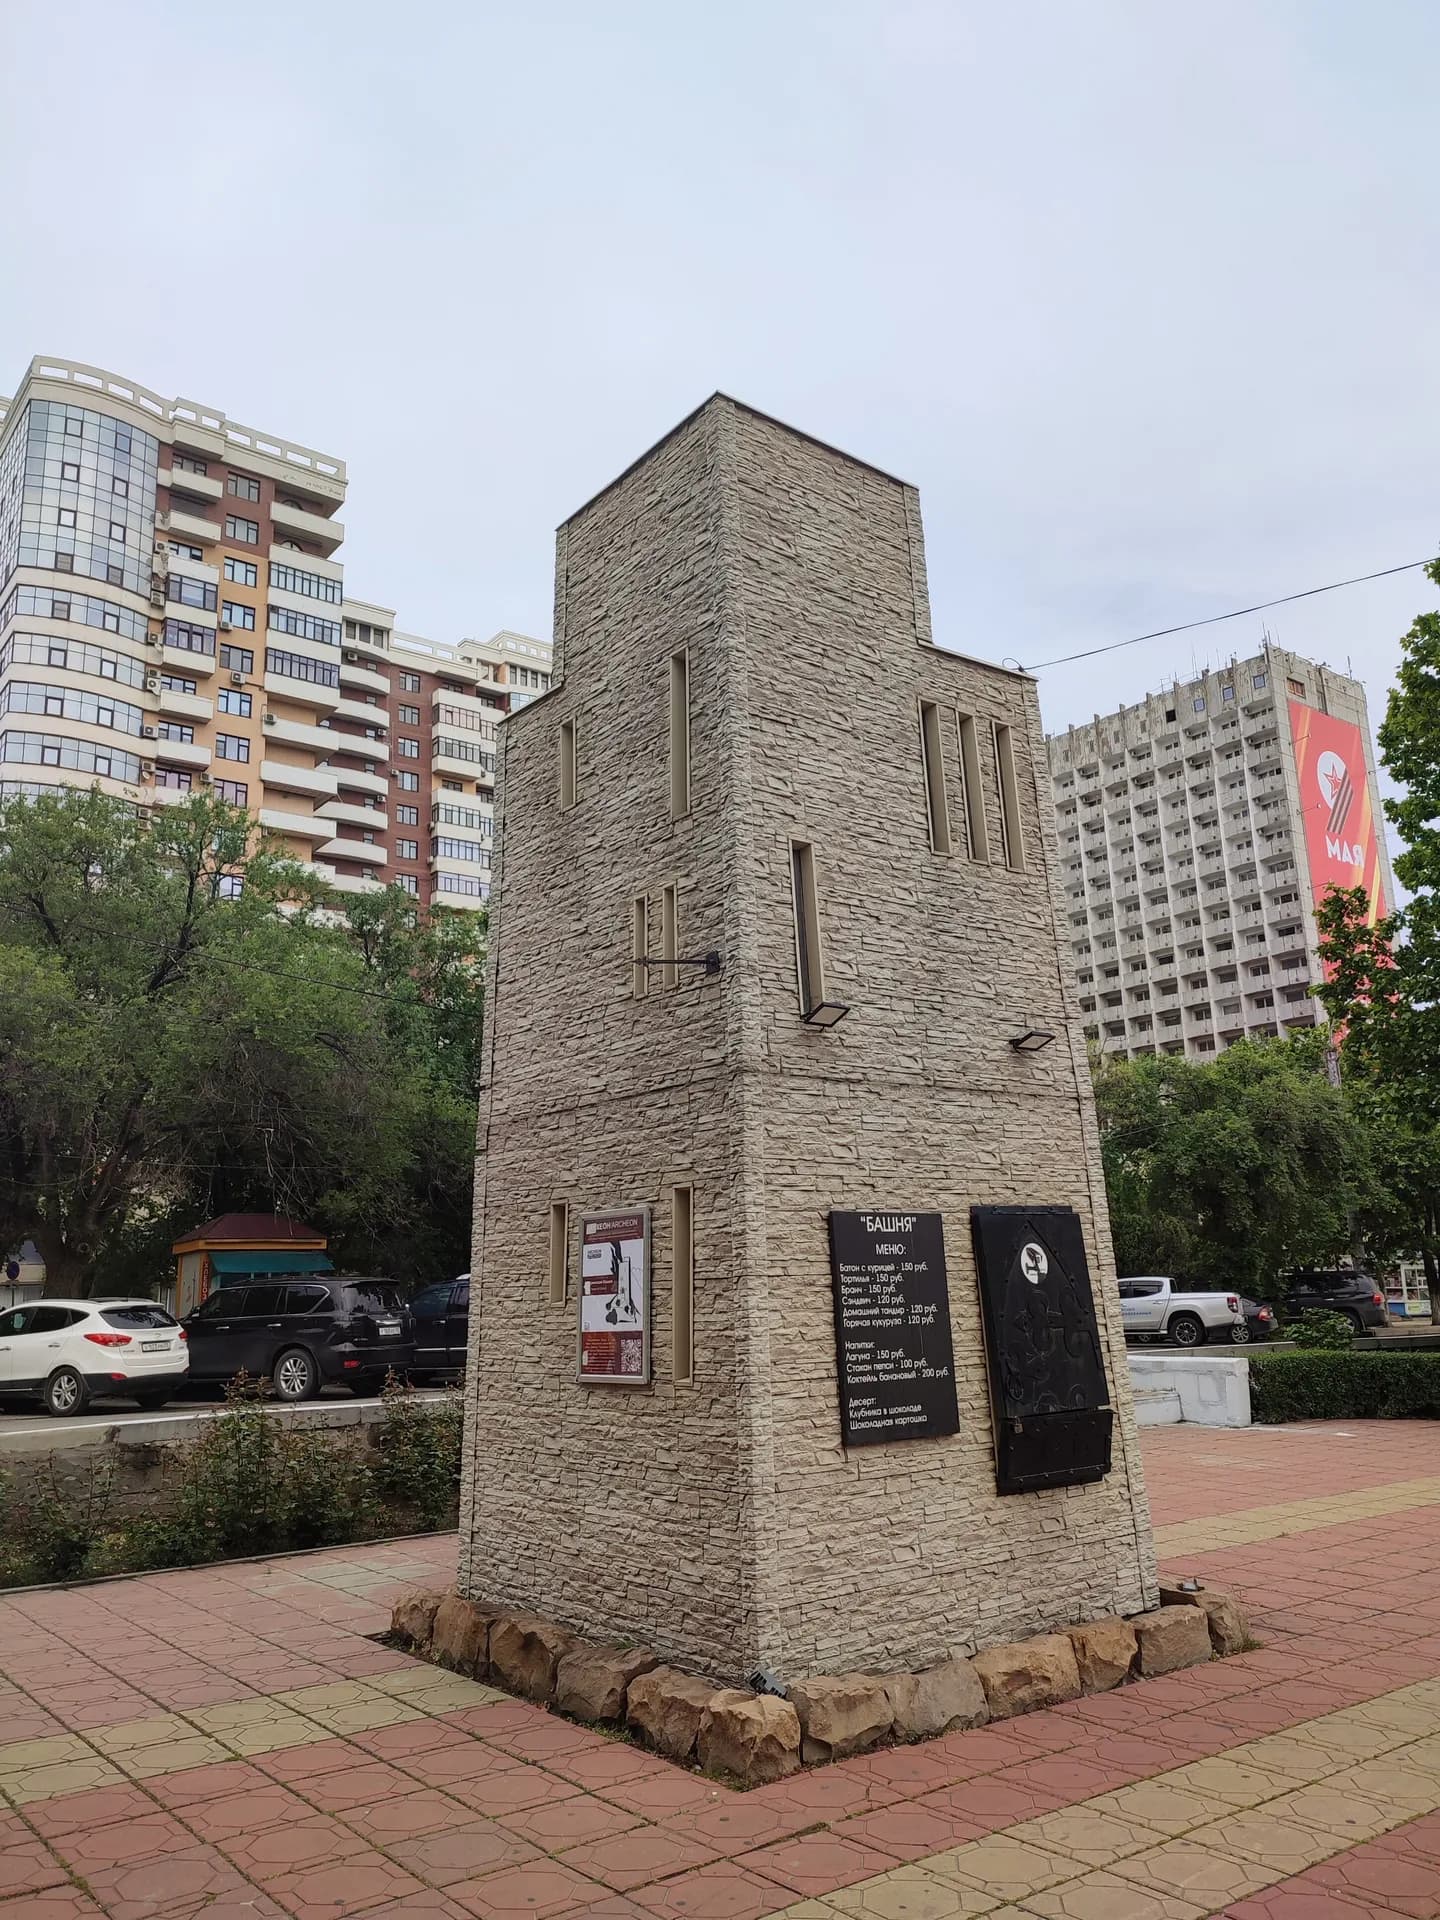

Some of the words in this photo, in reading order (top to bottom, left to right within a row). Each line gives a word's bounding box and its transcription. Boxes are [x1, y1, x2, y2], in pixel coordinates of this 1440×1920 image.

[1326, 834, 1365, 869] МАЯ
[612, 1218, 638, 1230] ARCHEON
[860, 1216, 916, 1232] "БАШНЯ"
[876, 1244, 907, 1255] МЕНЮ:
[840, 1263, 860, 1272] Батон
[868, 1263, 895, 1273] курицей
[901, 1262, 913, 1271] 150
[915, 1261, 928, 1272] руб.
[876, 1274, 888, 1282] 150
[890, 1273, 904, 1284] руб.
[841, 1286, 862, 1296] Бранч
[869, 1285, 881, 1293] 150
[842, 1297, 871, 1305] Сэндвич
[877, 1296, 890, 1304] 120
[891, 1294, 905, 1305] руб.
[843, 1306, 879, 1317] Домашний
[911, 1305, 923, 1313] 120
[924, 1304, 938, 1314] руб.
[843, 1318, 870, 1328] Горячая
[872, 1318, 902, 1328] кукуруза
[908, 1316, 920, 1325] 120
[922, 1315, 935, 1326] руб.
[846, 1352, 870, 1363] Лагуна
[877, 1350, 889, 1359] 150
[891, 1348, 905, 1360] руб.
[846, 1364, 872, 1373] Стакан
[900, 1360, 913, 1369] 100
[914, 1358, 928, 1369] руб.
[847, 1374, 878, 1384] Коктейль
[879, 1371, 916, 1382] банановый
[922, 1369, 935, 1378] 200
[936, 1367, 950, 1378] руб.
[849, 1398, 877, 1408] Десерт:
[849, 1408, 882, 1419] Клубника
[889, 1405, 922, 1415] шоколаде
[850, 1419, 893, 1430] Шоколадная
[895, 1415, 927, 1426] картошка
